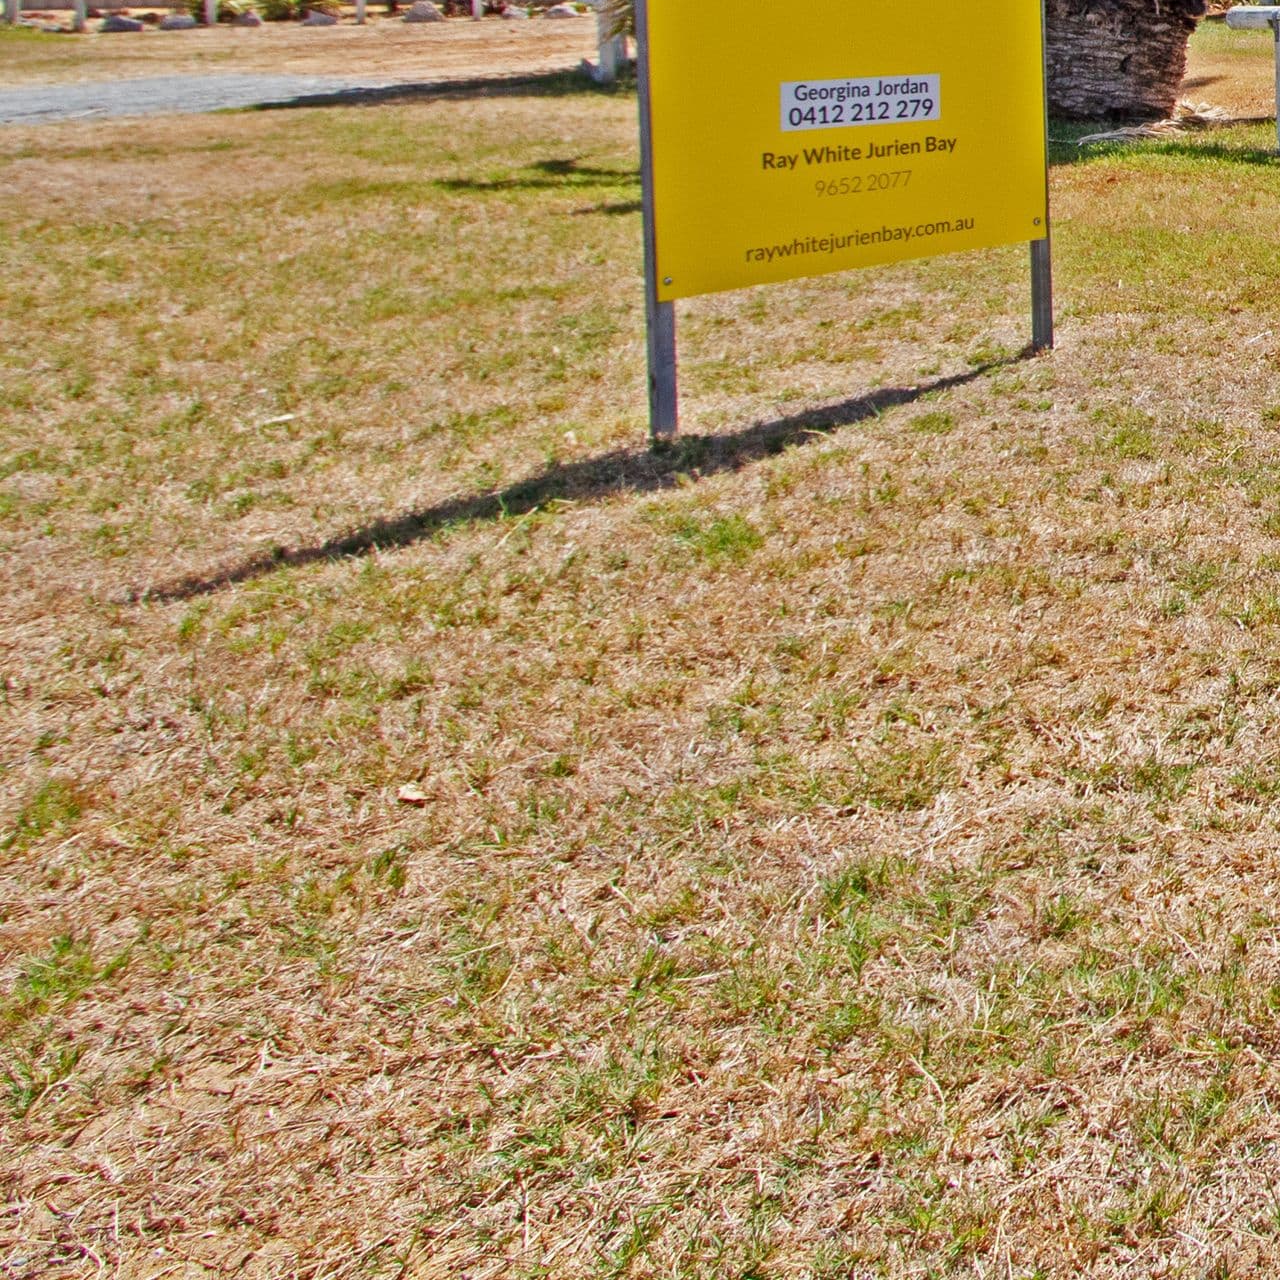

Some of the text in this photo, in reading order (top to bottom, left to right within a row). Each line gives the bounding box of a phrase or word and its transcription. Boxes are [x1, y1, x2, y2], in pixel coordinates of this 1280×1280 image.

[794, 78, 929, 103] Georgina Jordan
[789, 99, 933, 126] 0412 212 279
[762, 136, 957, 171] Ray White Jurien Bay
[814, 170, 912, 197] 9652 2077
[745, 218, 975, 263] raywhitejurienbay.com.au
